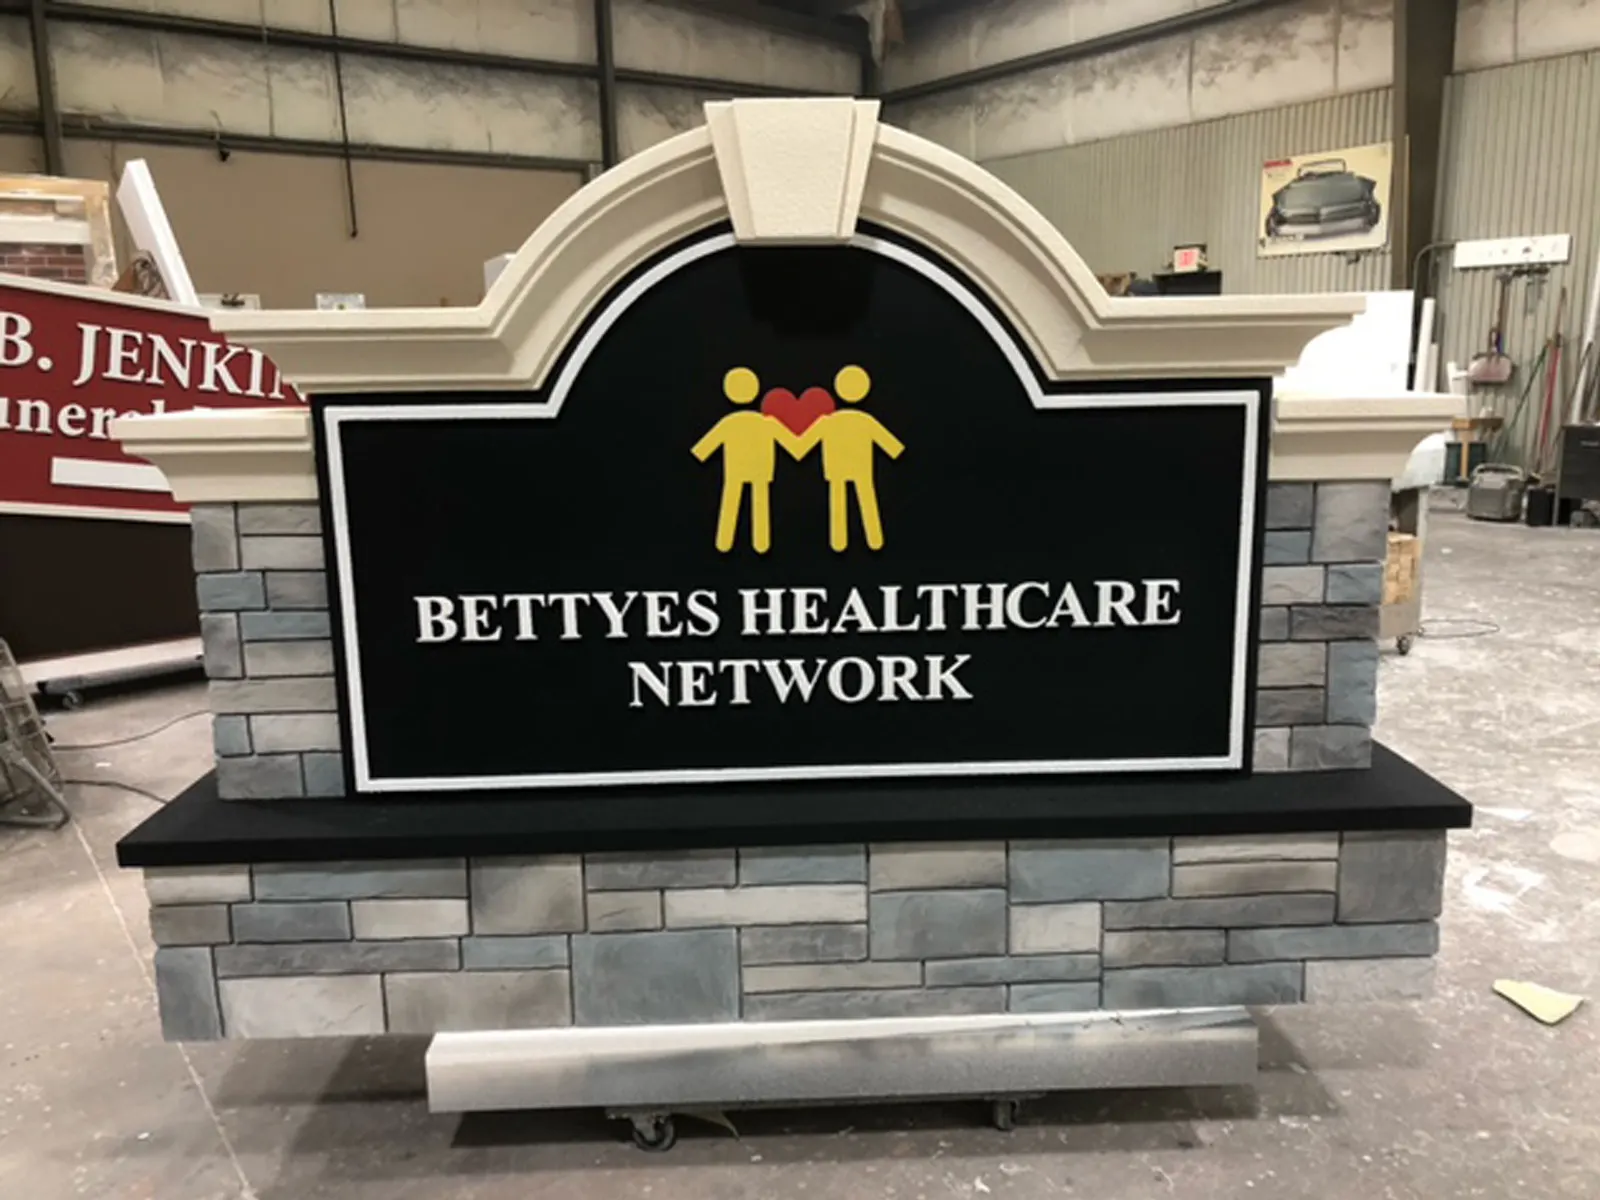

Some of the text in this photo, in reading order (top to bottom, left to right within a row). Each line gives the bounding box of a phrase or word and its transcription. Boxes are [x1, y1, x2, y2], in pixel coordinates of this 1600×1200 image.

[0, 311, 53, 371] B.
[413, 578, 1182, 643] BETTYES HEALTHCARE
[627, 653, 974, 707] NETWORK
